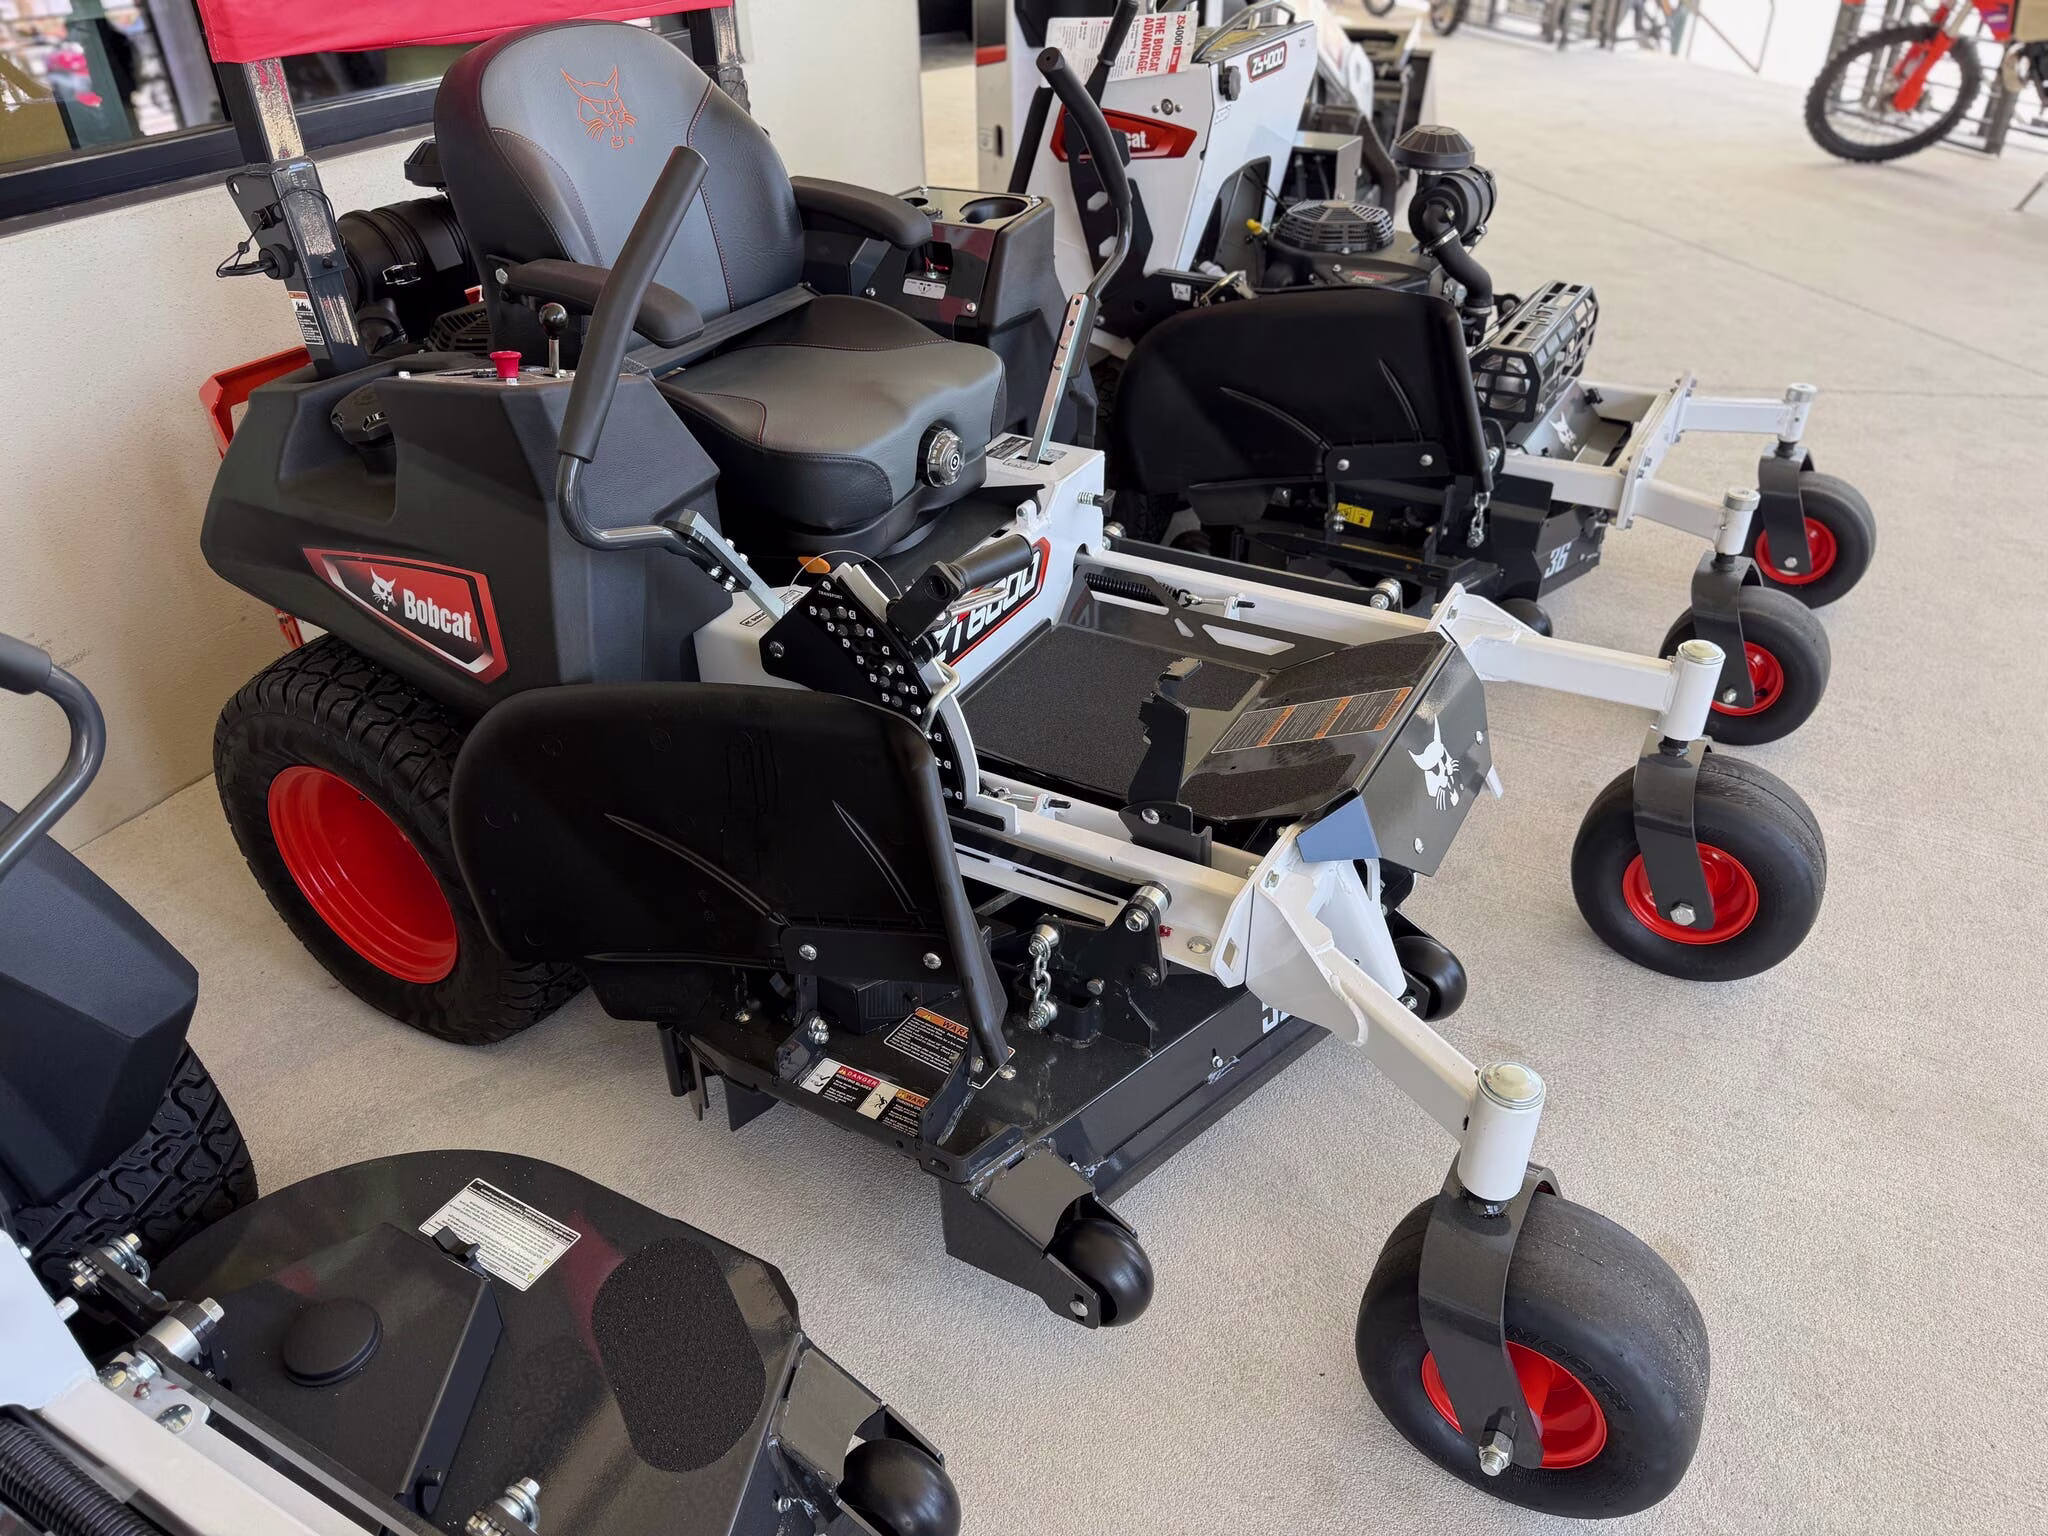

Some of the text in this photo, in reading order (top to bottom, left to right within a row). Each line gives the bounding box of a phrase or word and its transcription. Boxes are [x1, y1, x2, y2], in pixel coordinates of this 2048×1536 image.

[1136, 17, 1154, 75] ADVANTAGE:
[1148, 15, 1167, 73] THE BOBCAT
[1173, 14, 1187, 46] ZS4000
[1125, 131, 1146, 149] cat
[1543, 541, 1573, 579] 36
[818, 590, 843, 600] TRANSPORT
[402, 588, 473, 642] Bobcat
[846, 1071, 878, 1088] DANGER
